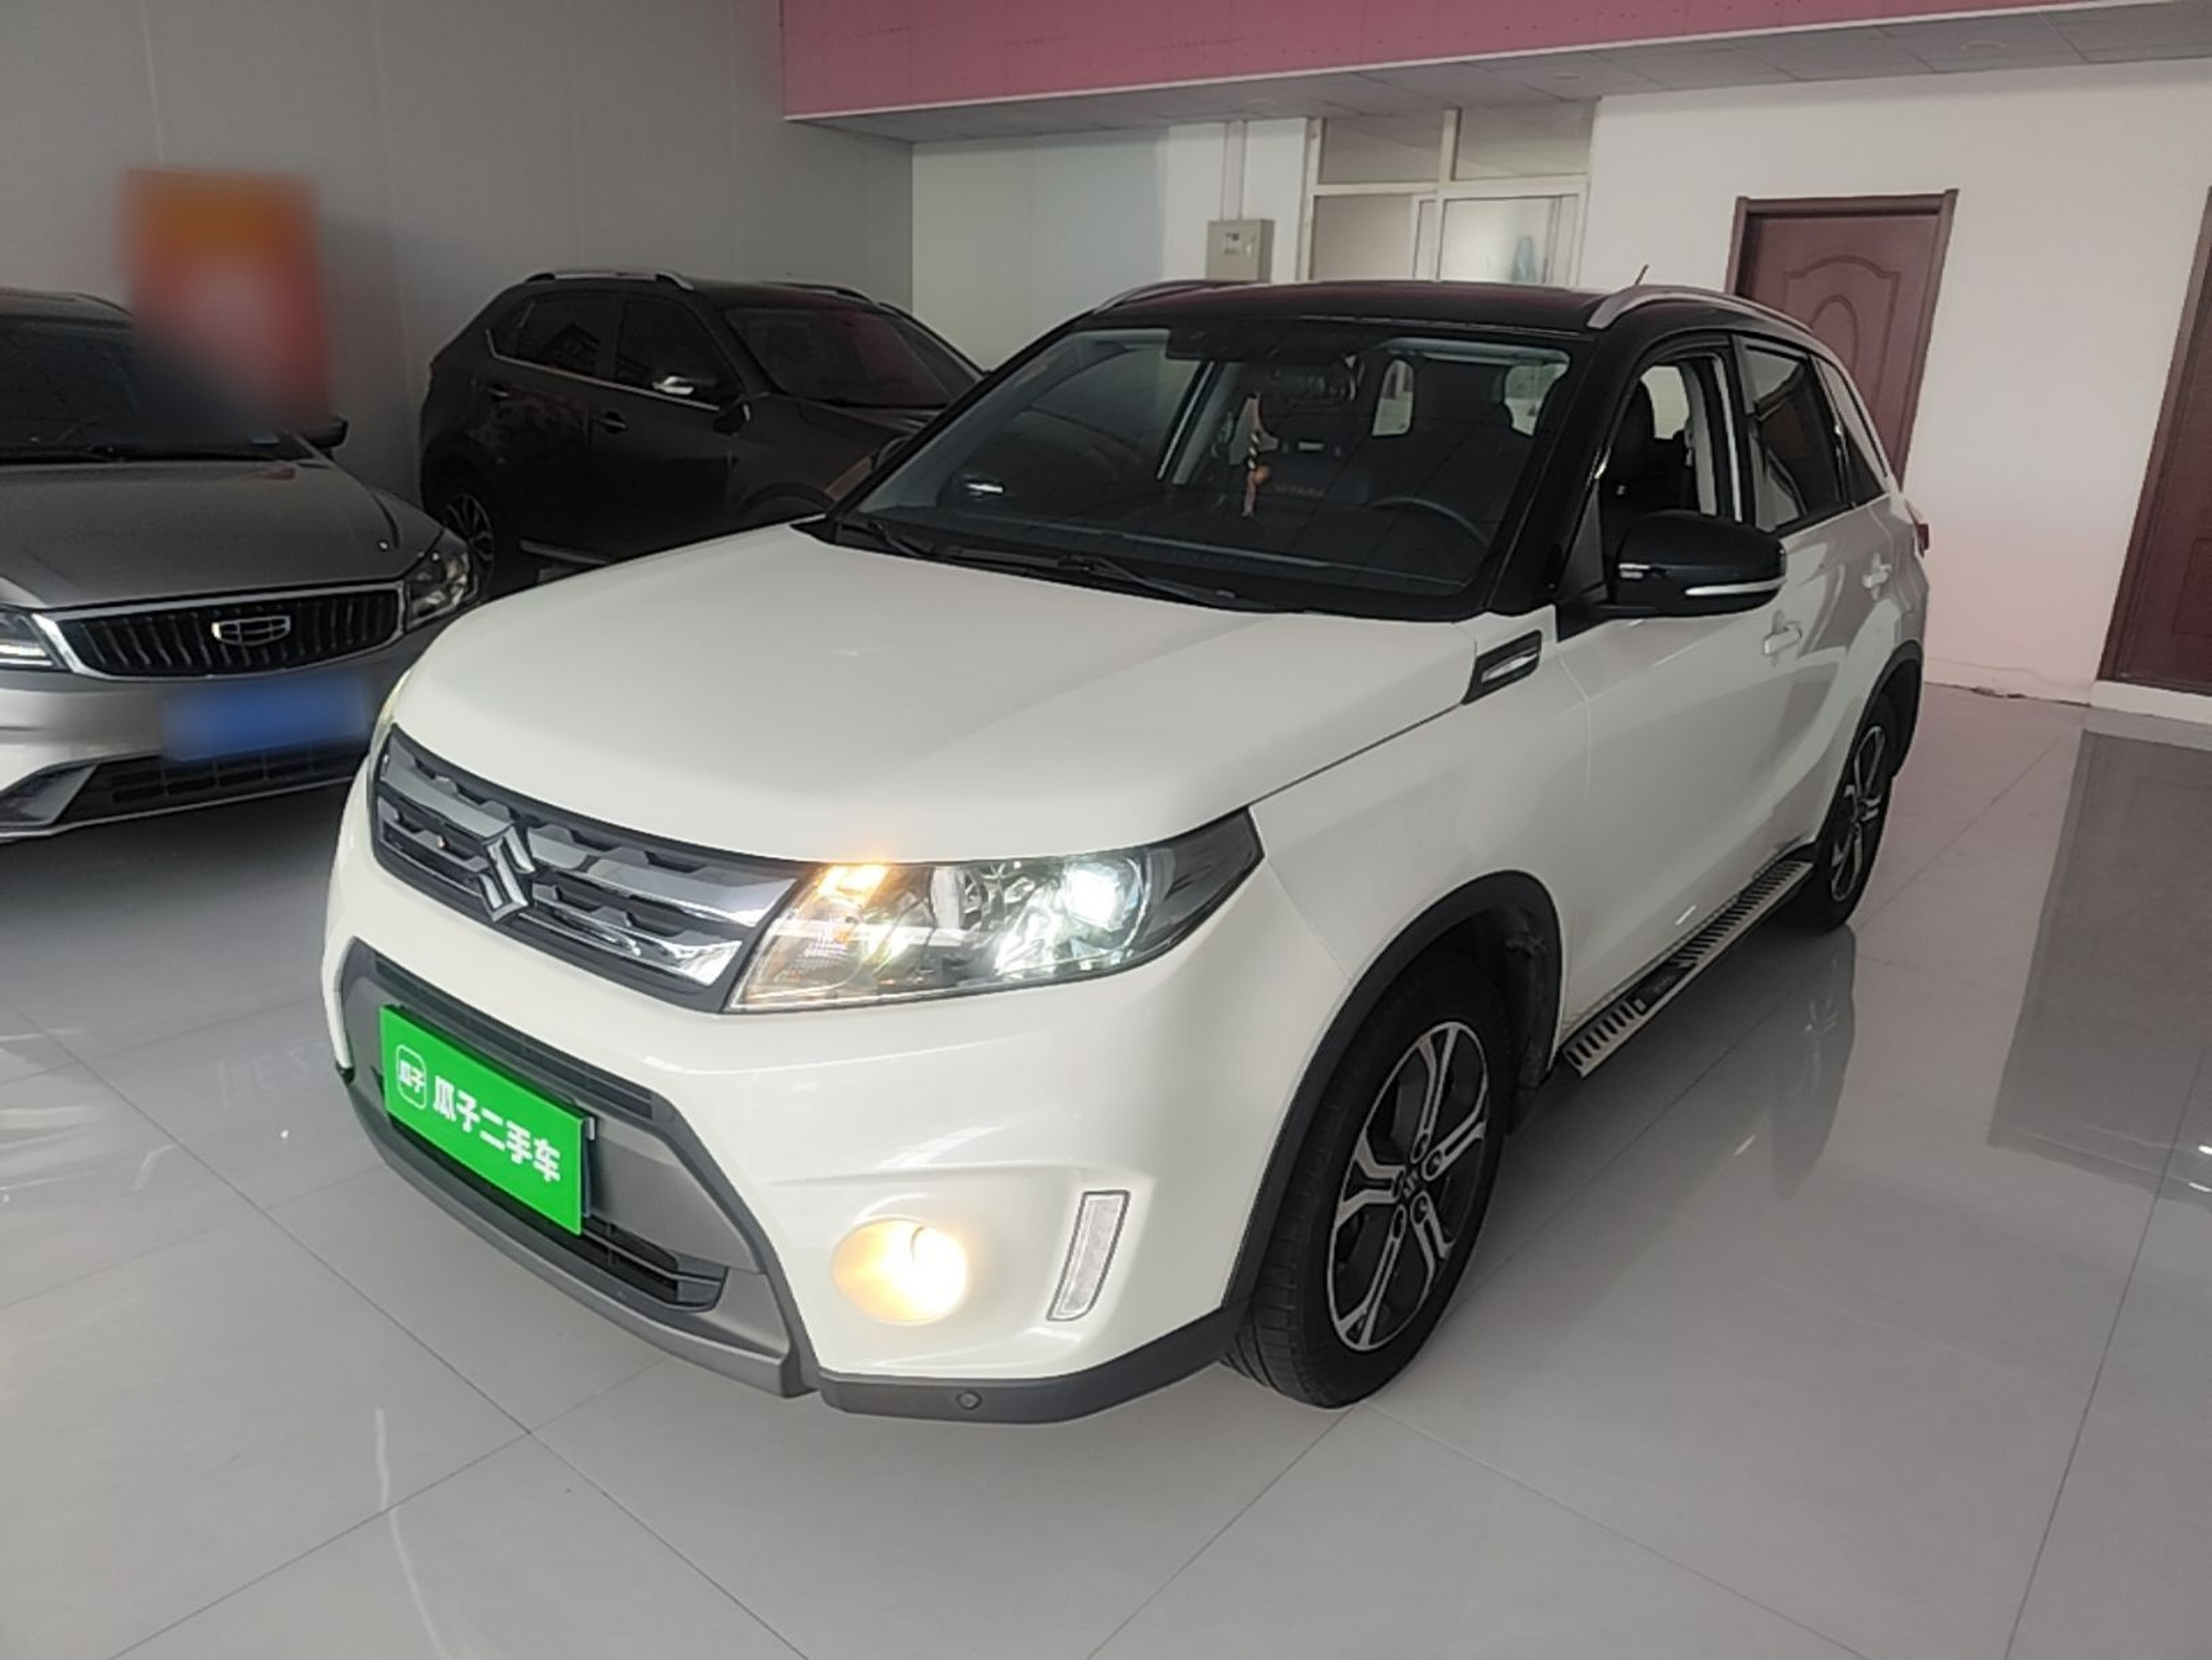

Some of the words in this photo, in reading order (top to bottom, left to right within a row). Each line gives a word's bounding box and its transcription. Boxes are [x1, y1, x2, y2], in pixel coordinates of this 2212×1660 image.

[397, 1059, 425, 1093] 瓜子
[433, 1075, 561, 1182] 瓜子二手车
